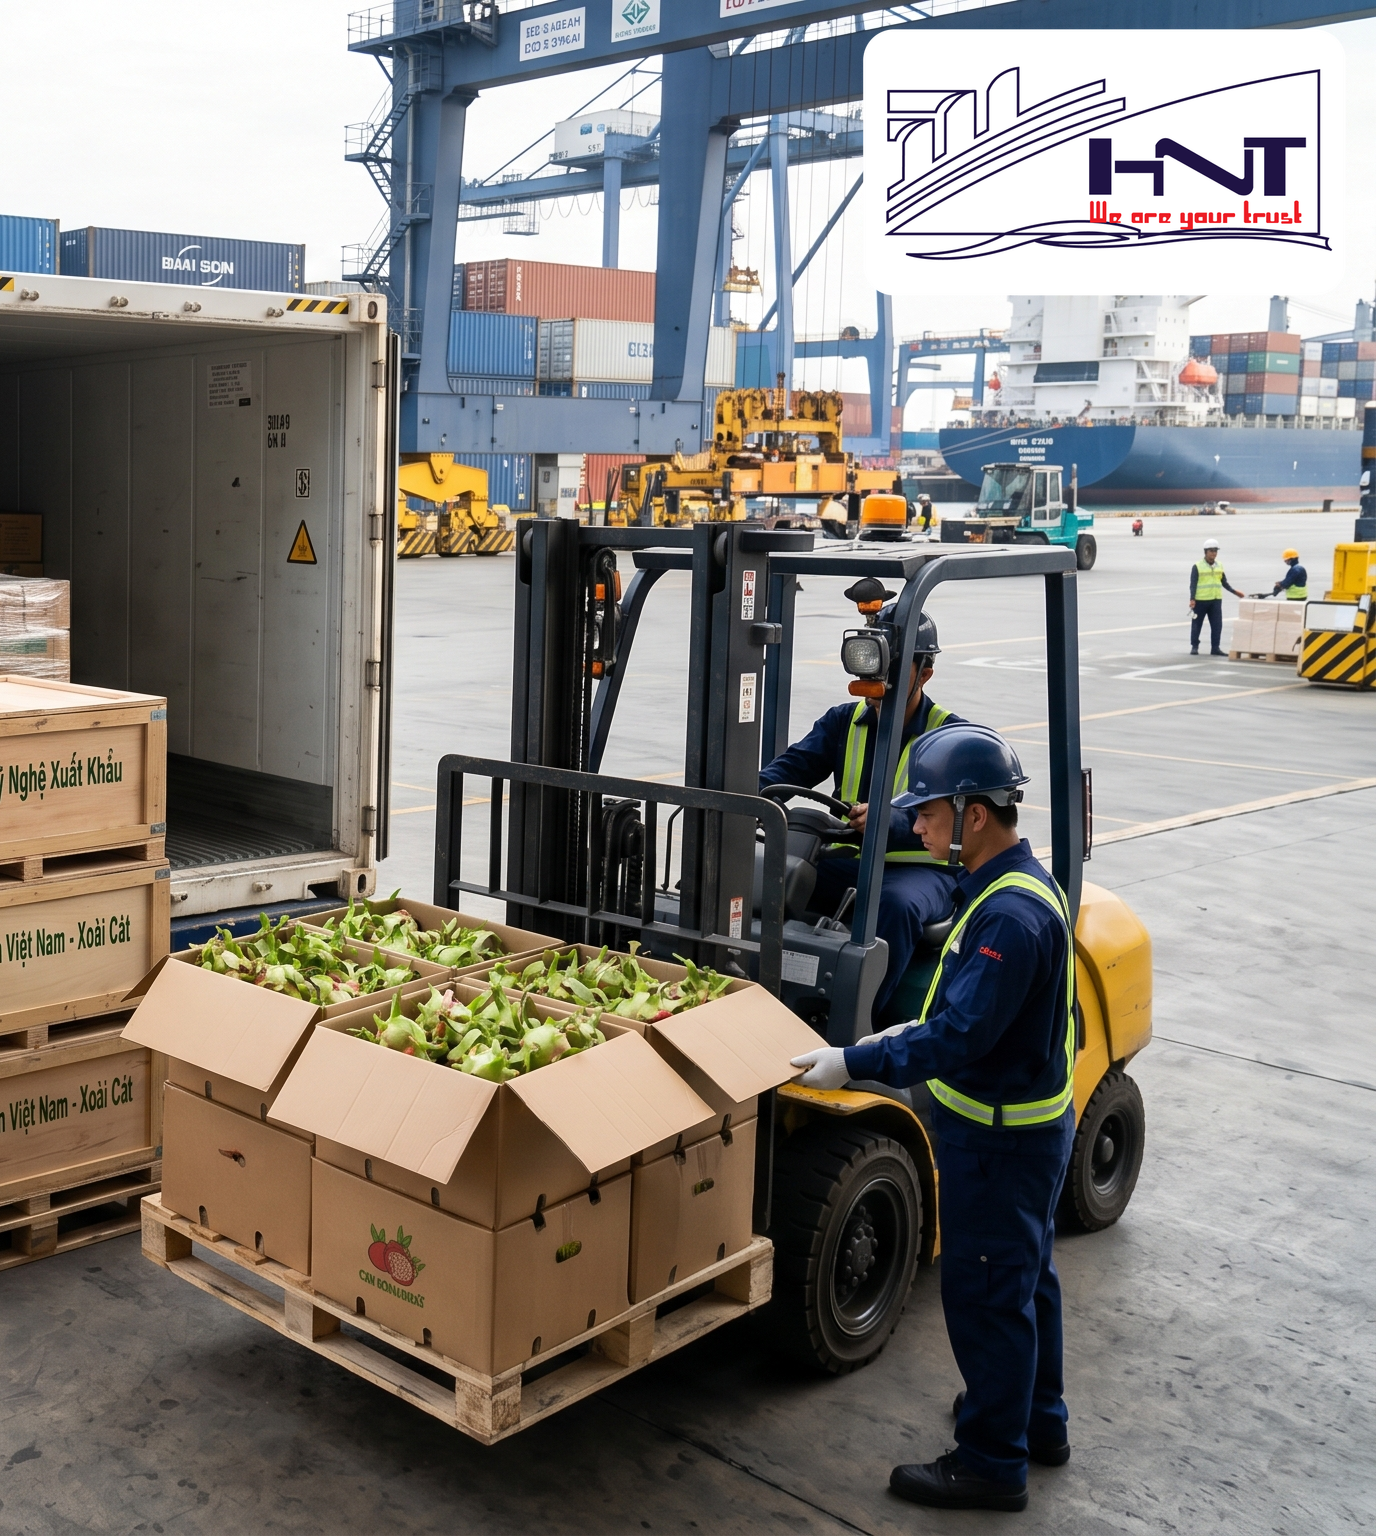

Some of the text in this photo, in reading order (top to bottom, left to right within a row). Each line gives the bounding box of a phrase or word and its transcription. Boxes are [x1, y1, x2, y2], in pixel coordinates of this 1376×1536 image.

[9, 761, 46, 801] Nghệ
[50, 752, 82, 789] Xuất
[87, 748, 122, 785] Khẩu
[6, 930, 33, 968] Việt
[36, 928, 65, 957] Nam
[77, 917, 105, 950] Xoài
[109, 914, 131, 944] Cát
[9, 1098, 35, 1135] Việt
[39, 1095, 68, 1124] Nam
[80, 1080, 107, 1114] Xoài
[111, 1074, 133, 1105] Cát
